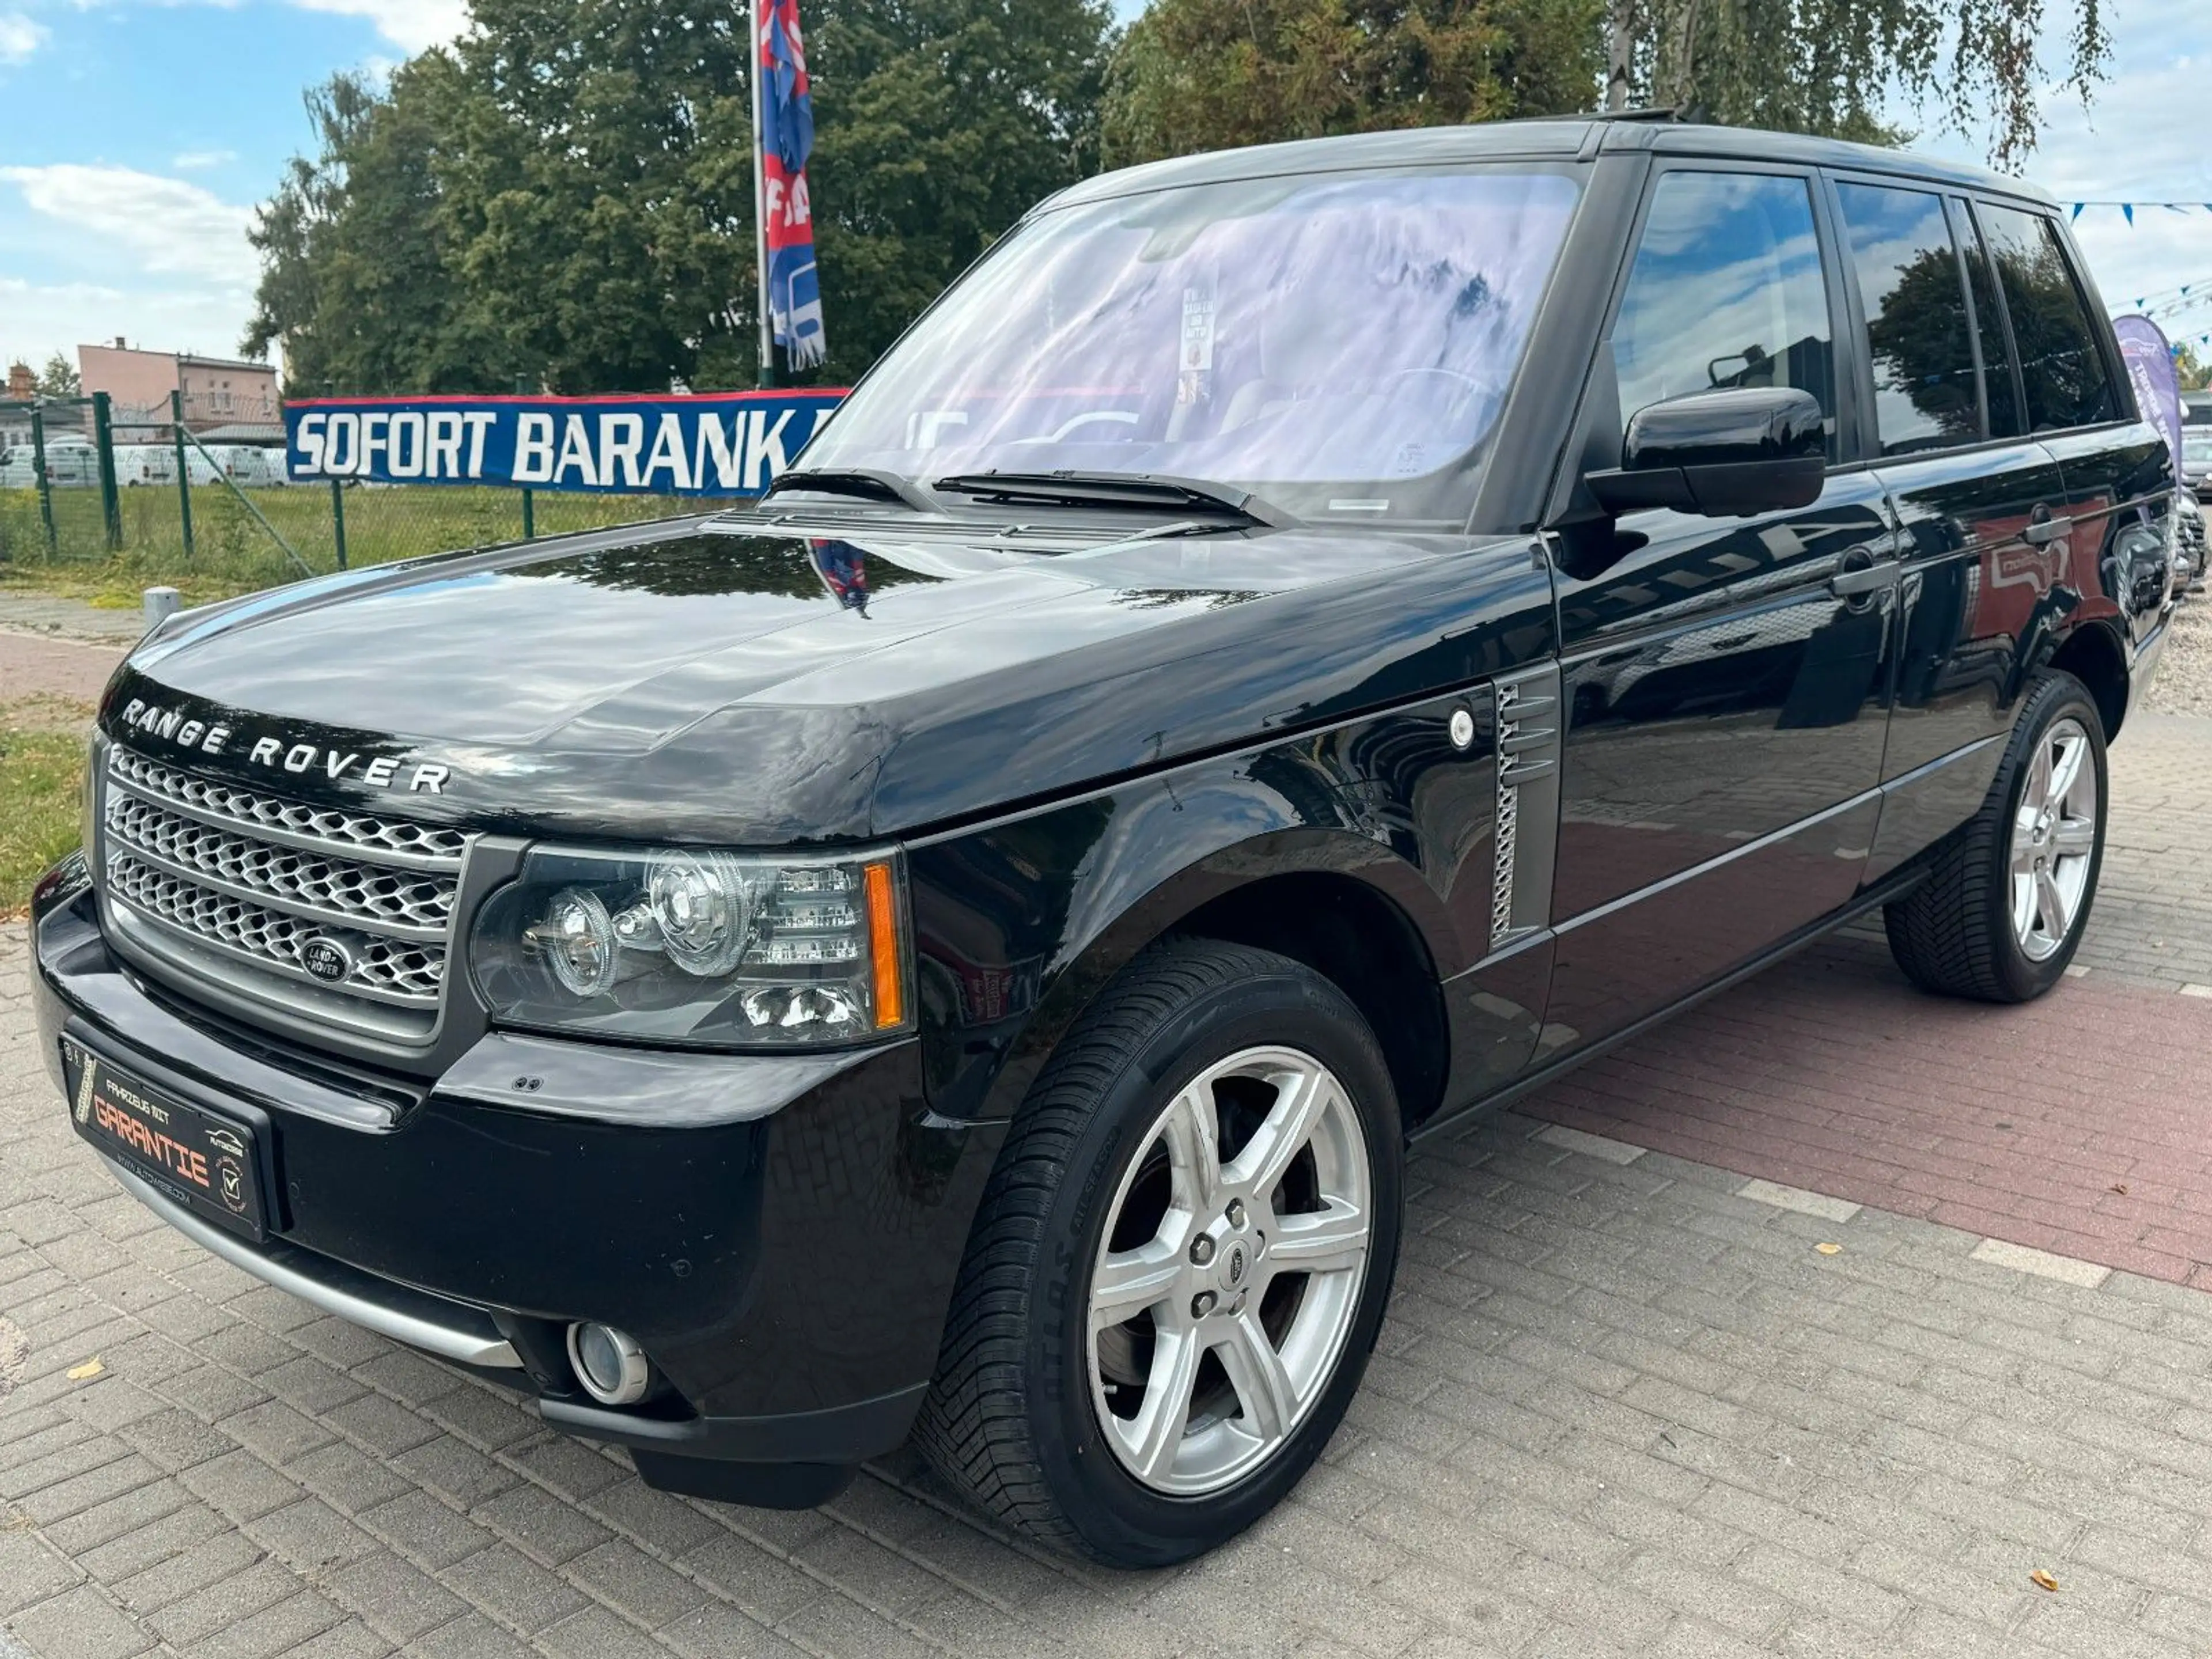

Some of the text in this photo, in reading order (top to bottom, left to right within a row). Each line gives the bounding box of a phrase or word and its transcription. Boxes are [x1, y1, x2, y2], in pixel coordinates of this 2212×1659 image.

[294, 411, 497, 478] SOFORT
[511, 408, 835, 490] BARANK
[122, 698, 451, 795] RANGE ROVER
[309, 947, 332, 963] LAND
[311, 959, 339, 976] ROVER
[94, 1094, 210, 1188] GARANTIE
